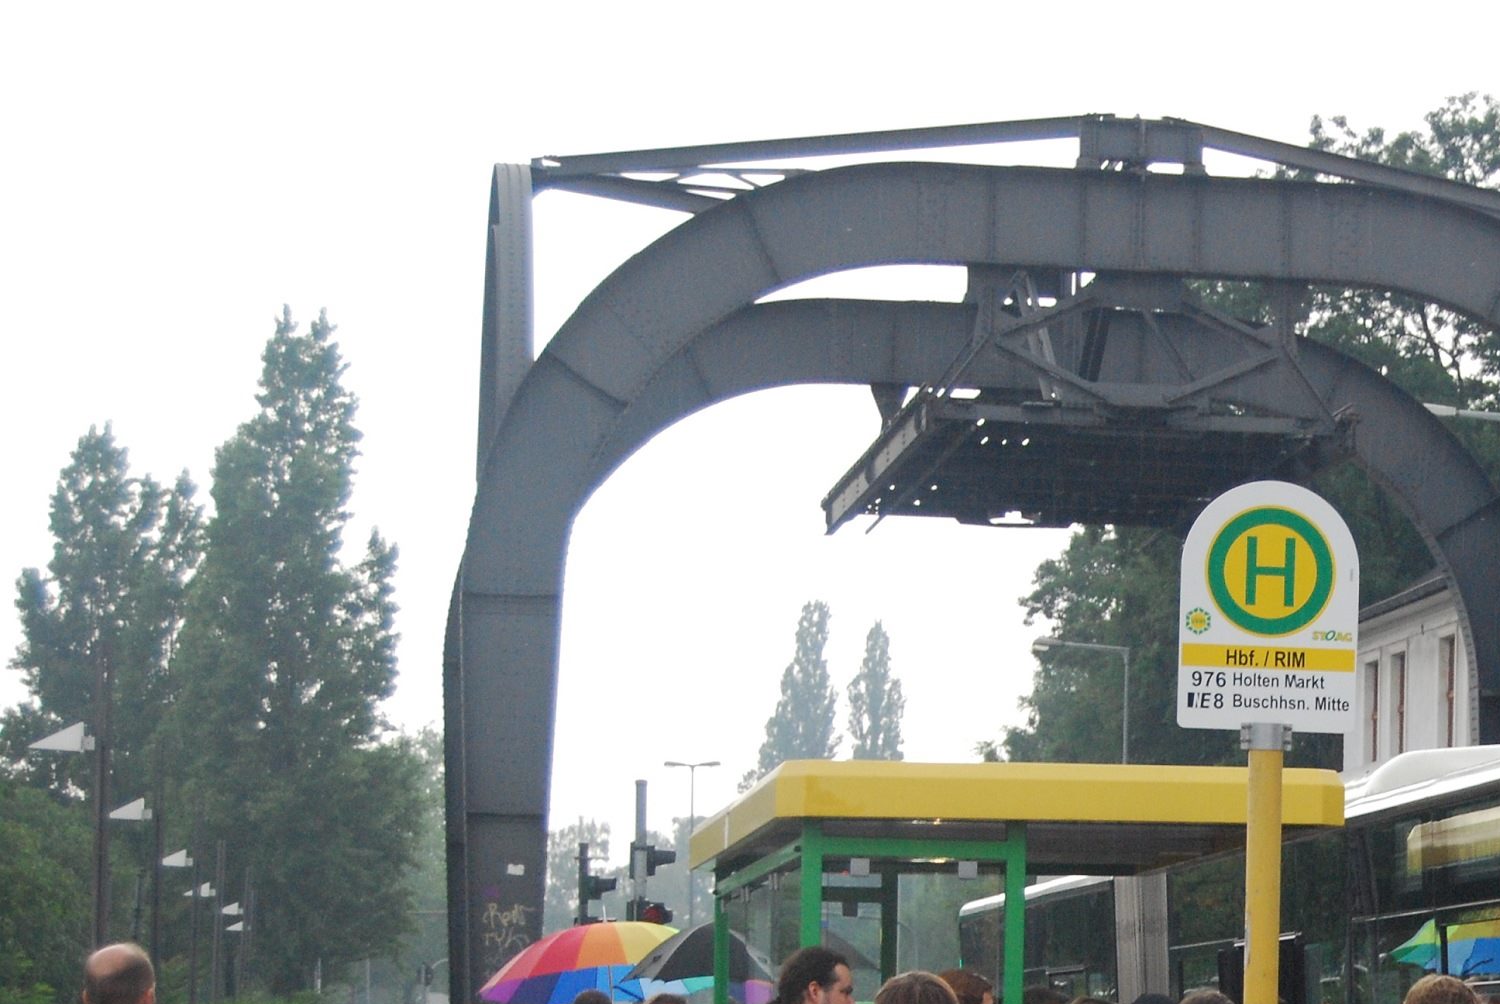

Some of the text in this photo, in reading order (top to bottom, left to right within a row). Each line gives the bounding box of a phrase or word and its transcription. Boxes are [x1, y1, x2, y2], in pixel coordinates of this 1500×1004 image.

[1245, 536, 1296, 607] H
[1226, 649, 1259, 666] Hbf.
[1274, 651, 1306, 668] RIM
[1191, 671, 1325, 690] 976 Holten Markt
[1232, 693, 1310, 711] Buschhsn.
[1314, 697, 1350, 712] Mitte
